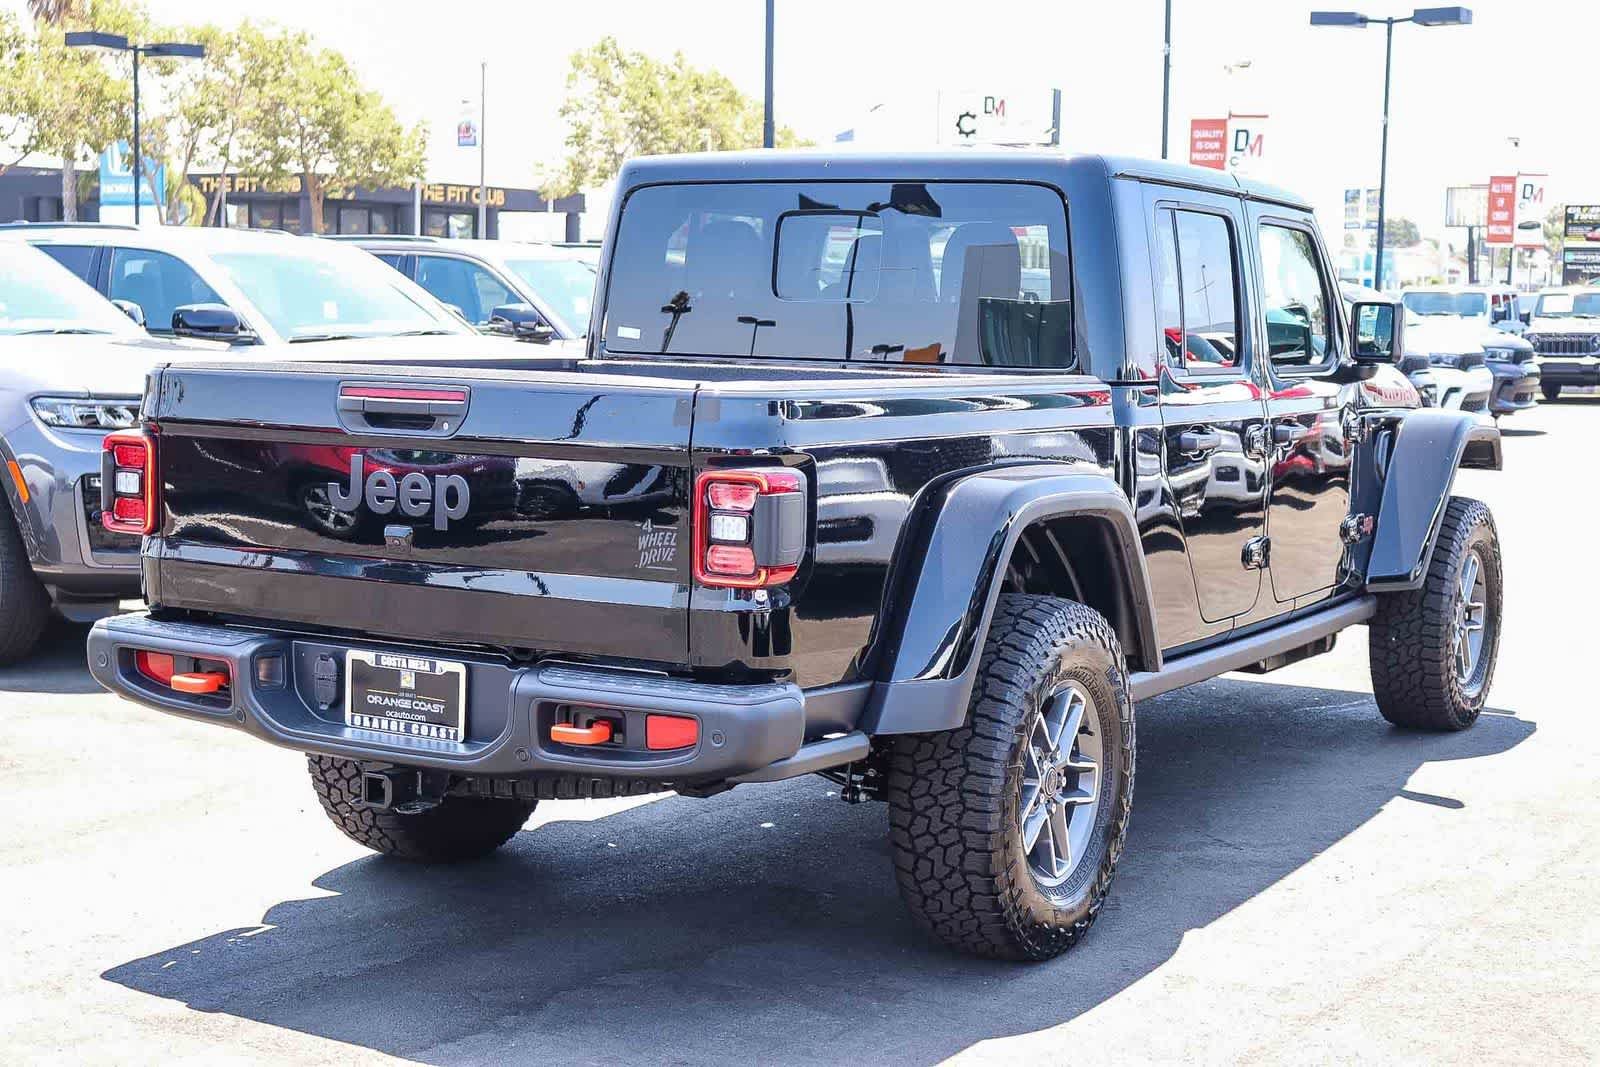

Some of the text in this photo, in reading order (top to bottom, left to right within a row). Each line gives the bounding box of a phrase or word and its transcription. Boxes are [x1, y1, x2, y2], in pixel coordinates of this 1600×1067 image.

[1193, 130, 1225, 139] QUALITY
[1192, 152, 1225, 161] PRIORITY
[200, 176, 301, 192] THE FIT CB
[447, 186, 470, 203] FIT
[327, 453, 471, 531] Jeep
[642, 518, 653, 533] 4
[638, 532, 678, 551] WHEEL
[639, 547, 676, 569] DRIVE
[381, 655, 431, 672] COSTA MESA
[366, 694, 412, 709] ORANGE
[412, 700, 445, 714] COAST
[385, 710, 427, 723] ocauto.com
[353, 715, 456, 739] ORANGE COAST
